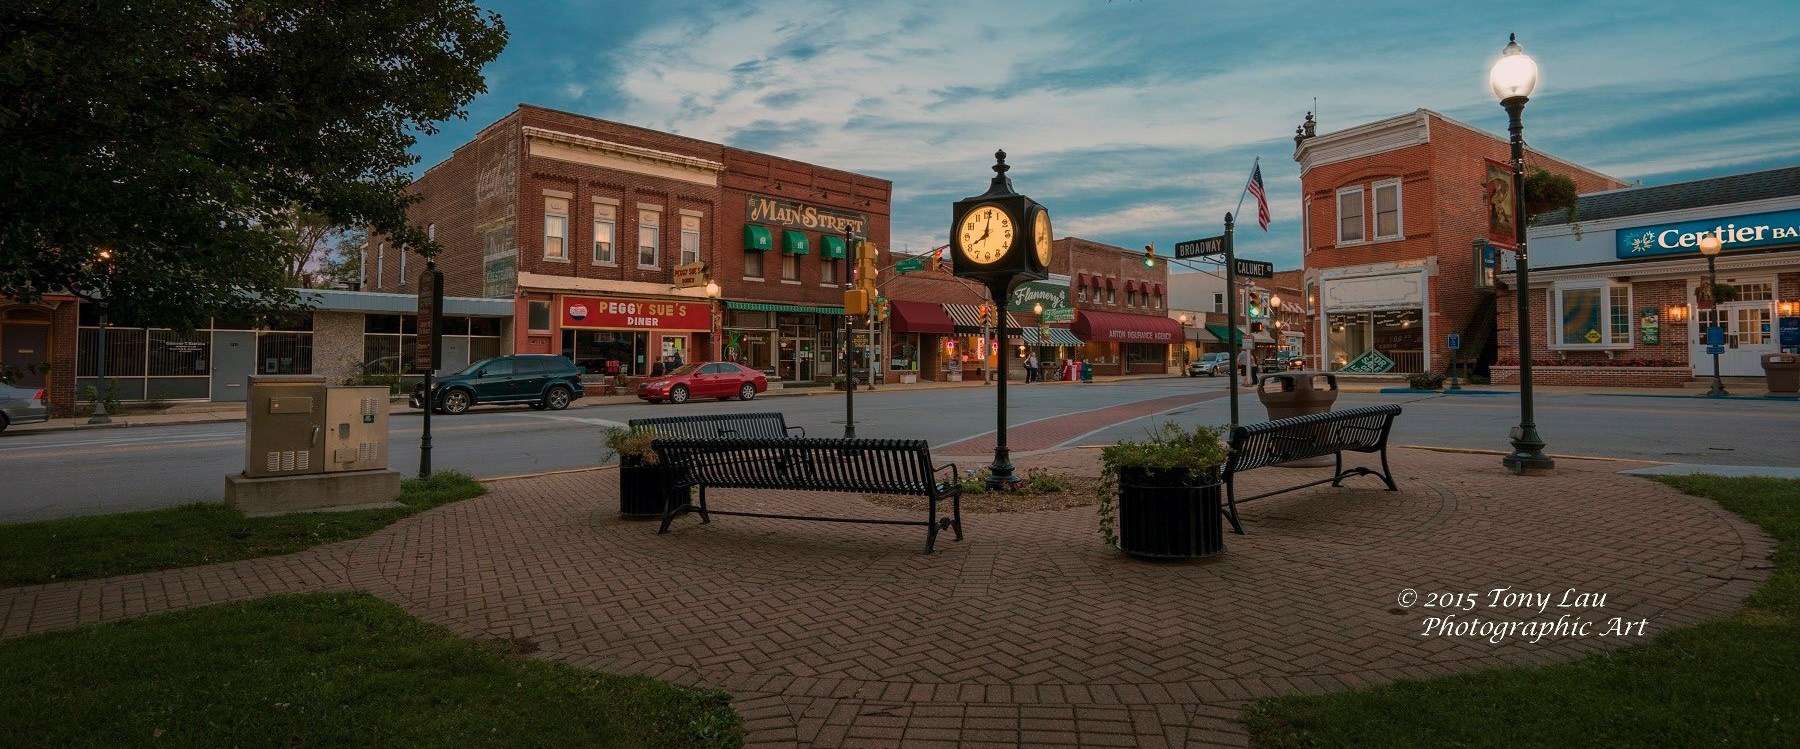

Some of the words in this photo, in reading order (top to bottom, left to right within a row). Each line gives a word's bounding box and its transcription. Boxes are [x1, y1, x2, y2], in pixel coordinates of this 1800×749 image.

[1773, 228, 1800, 239] BA
[1180, 239, 1222, 256] BROADWAY
[1237, 261, 1264, 275] CALUMET
[599, 301, 643, 315] PEGGY
[648, 302, 687, 317] SUE'S
[627, 316, 659, 326] DINER
